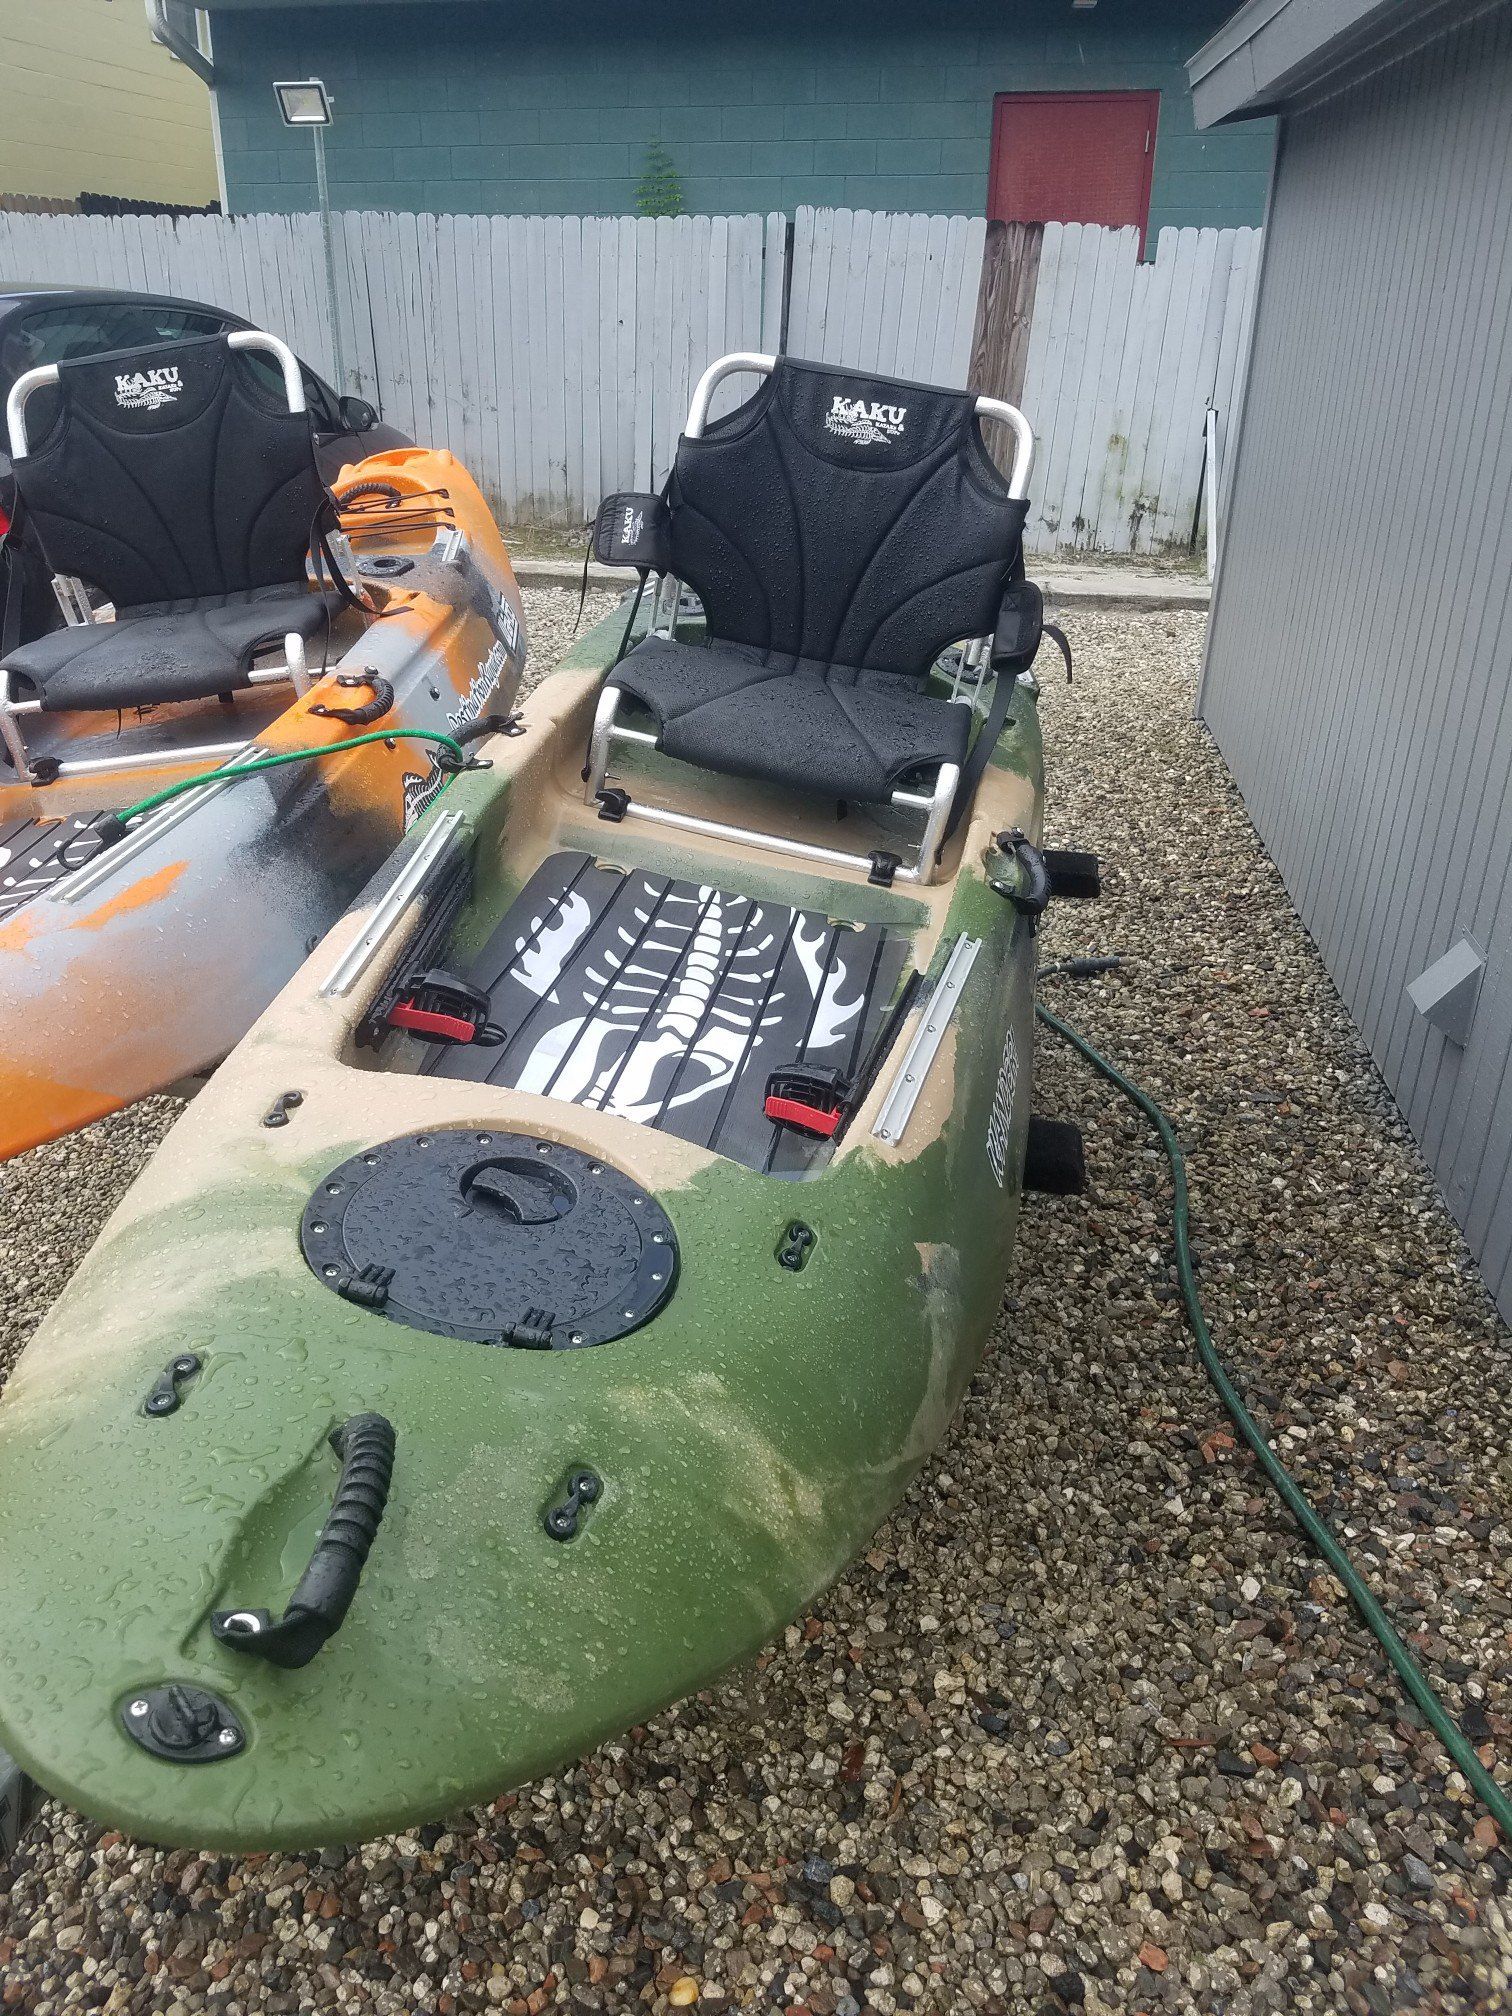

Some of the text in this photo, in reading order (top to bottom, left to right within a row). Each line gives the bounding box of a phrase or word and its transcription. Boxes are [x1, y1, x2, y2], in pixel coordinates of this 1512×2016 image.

[115, 366, 179, 392] KAKU
[831, 396, 907, 425] KAKU
[621, 506, 634, 544] KAKU
